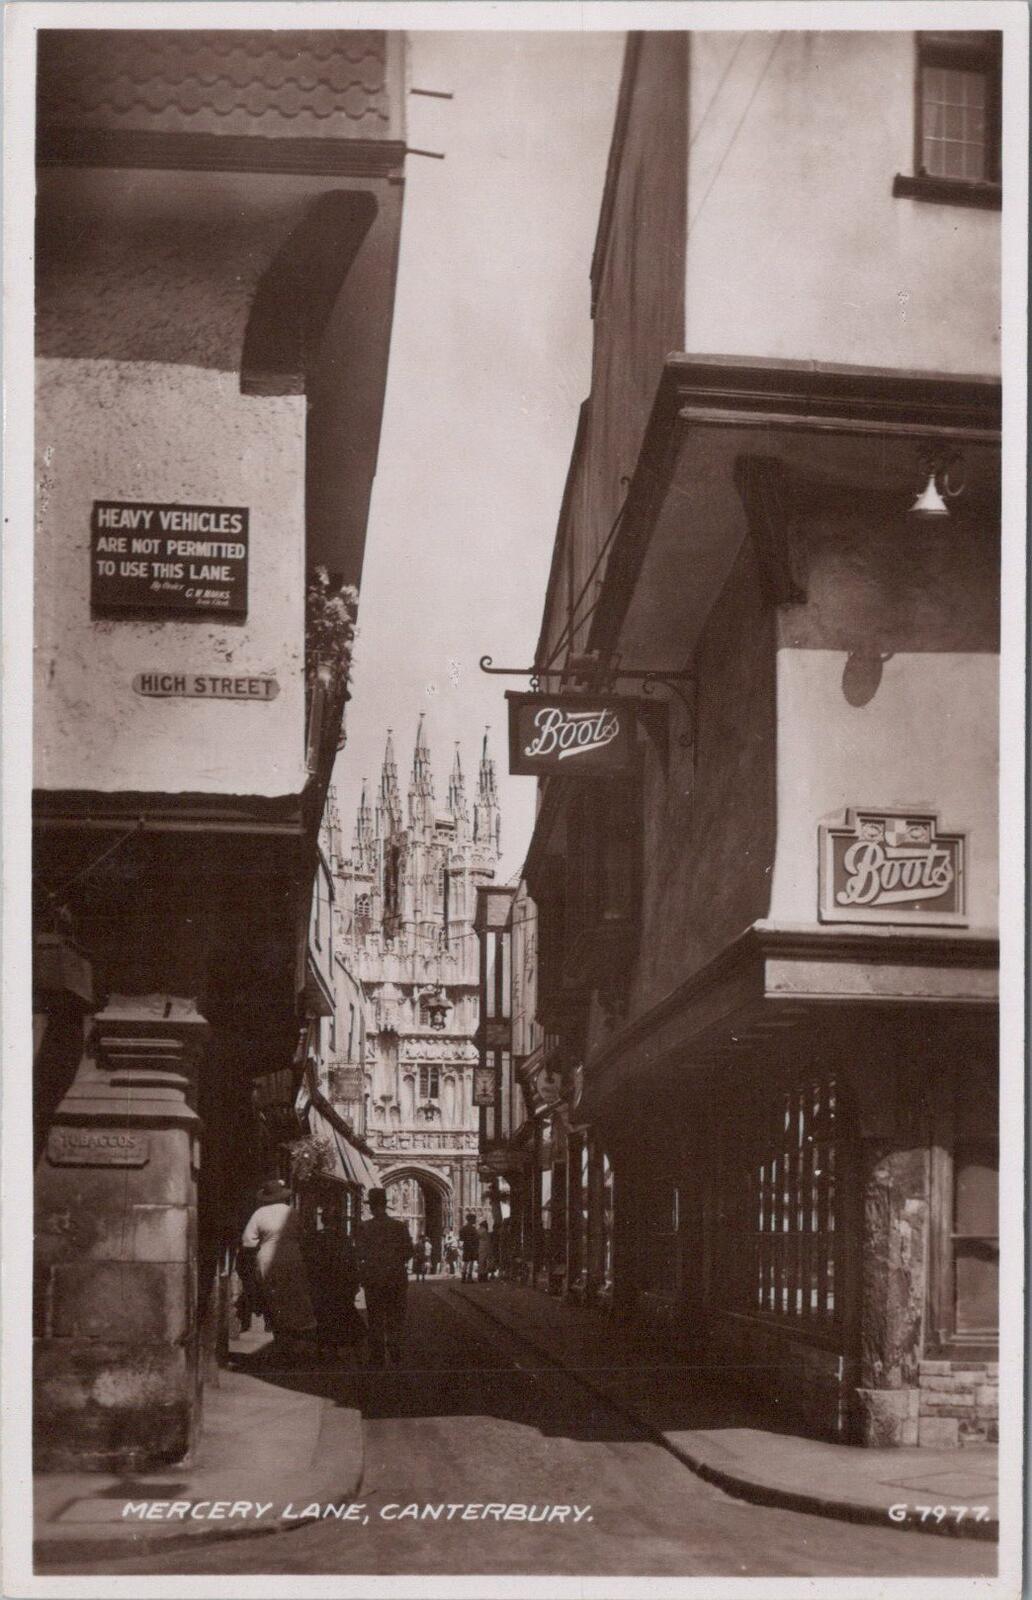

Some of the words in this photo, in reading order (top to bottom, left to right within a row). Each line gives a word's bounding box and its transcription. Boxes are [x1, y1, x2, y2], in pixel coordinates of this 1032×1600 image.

[98, 508, 154, 528] HEAVY
[159, 511, 243, 533] VEHICLES
[97, 537, 127, 553] ARE
[132, 539, 161, 554] NOT
[167, 540, 246, 559] PERMITTED
[97, 561, 115, 576] TO
[120, 562, 148, 577] USE
[152, 563, 184, 579] THIS
[190, 565, 236, 581] LANE.
[141, 675, 186, 692] HIGH
[194, 678, 273, 695] STREET
[524, 707, 620, 760] Boots
[836, 841, 954, 906] Boots
